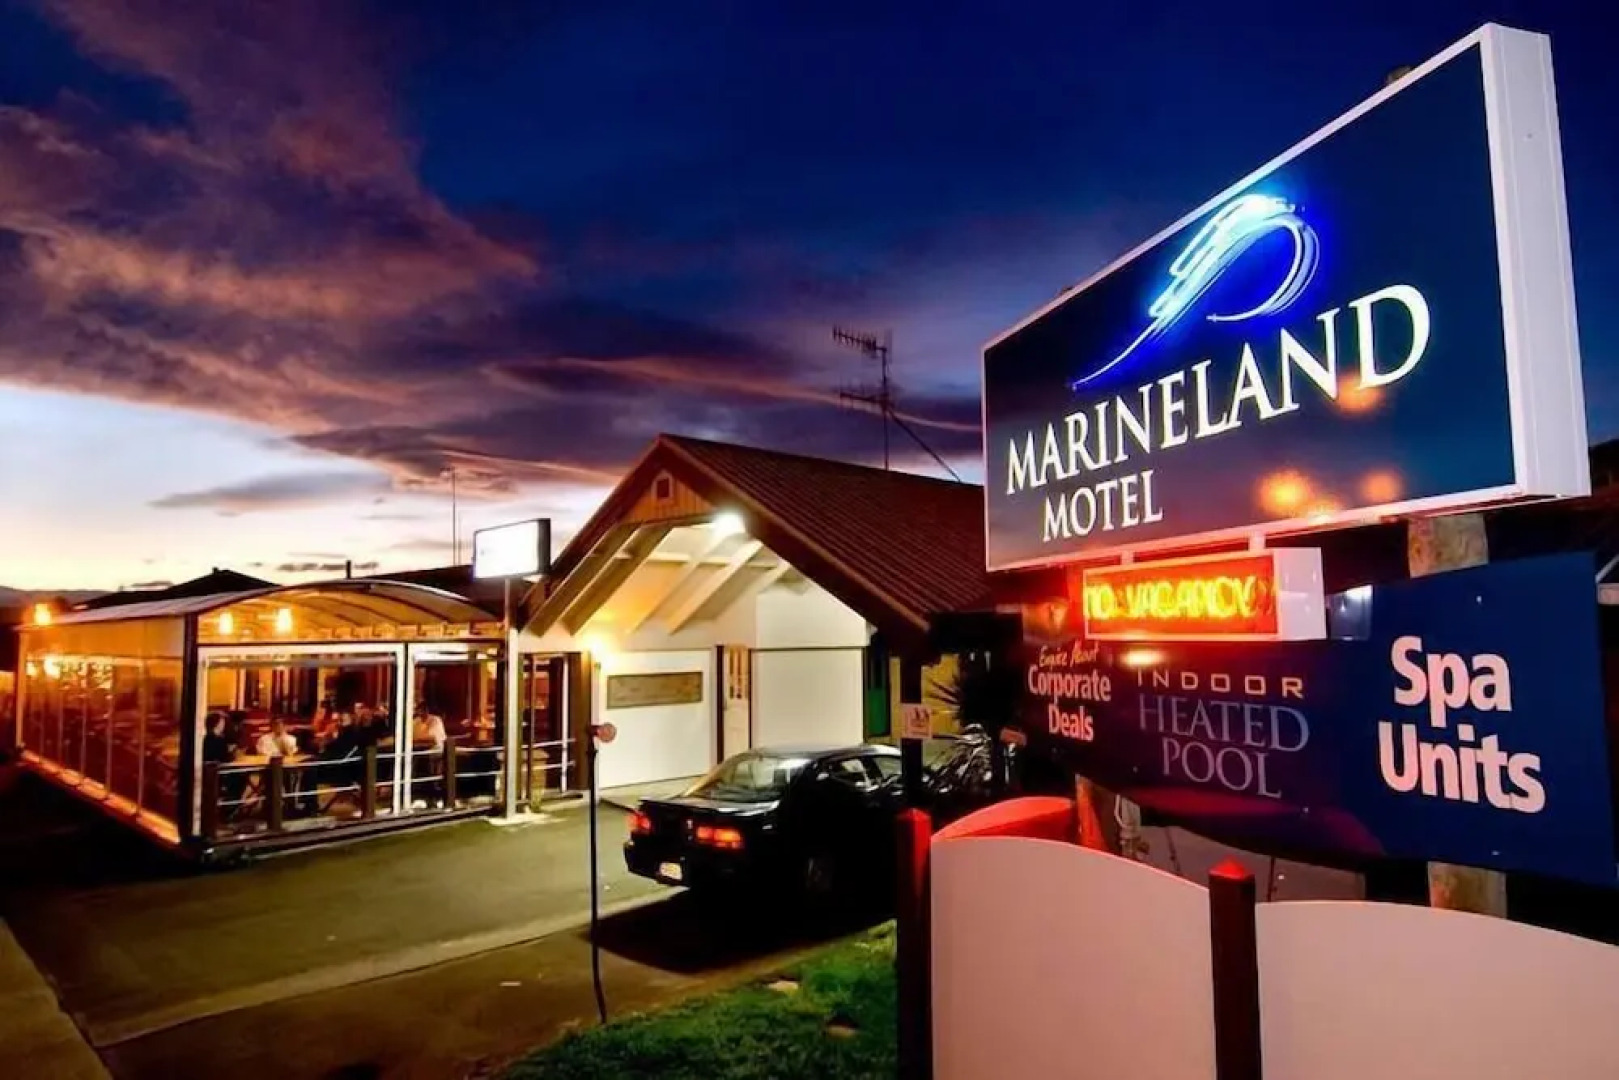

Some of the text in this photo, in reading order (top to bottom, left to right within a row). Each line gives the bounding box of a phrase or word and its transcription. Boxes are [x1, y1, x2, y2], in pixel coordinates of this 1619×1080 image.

[1006, 284, 1430, 495] MARINELAND
[1043, 470, 1163, 542] MOTEL
[1126, 576, 1256, 619] VACANCY
[1028, 664, 1111, 706] Corporate
[1137, 668, 1304, 698] INDOOR
[1391, 635, 1512, 728] Spa
[1048, 703, 1094, 742] Deals
[1139, 692, 1310, 752] HEATED
[1162, 736, 1282, 798] POOL
[1378, 721, 1546, 814] Units
